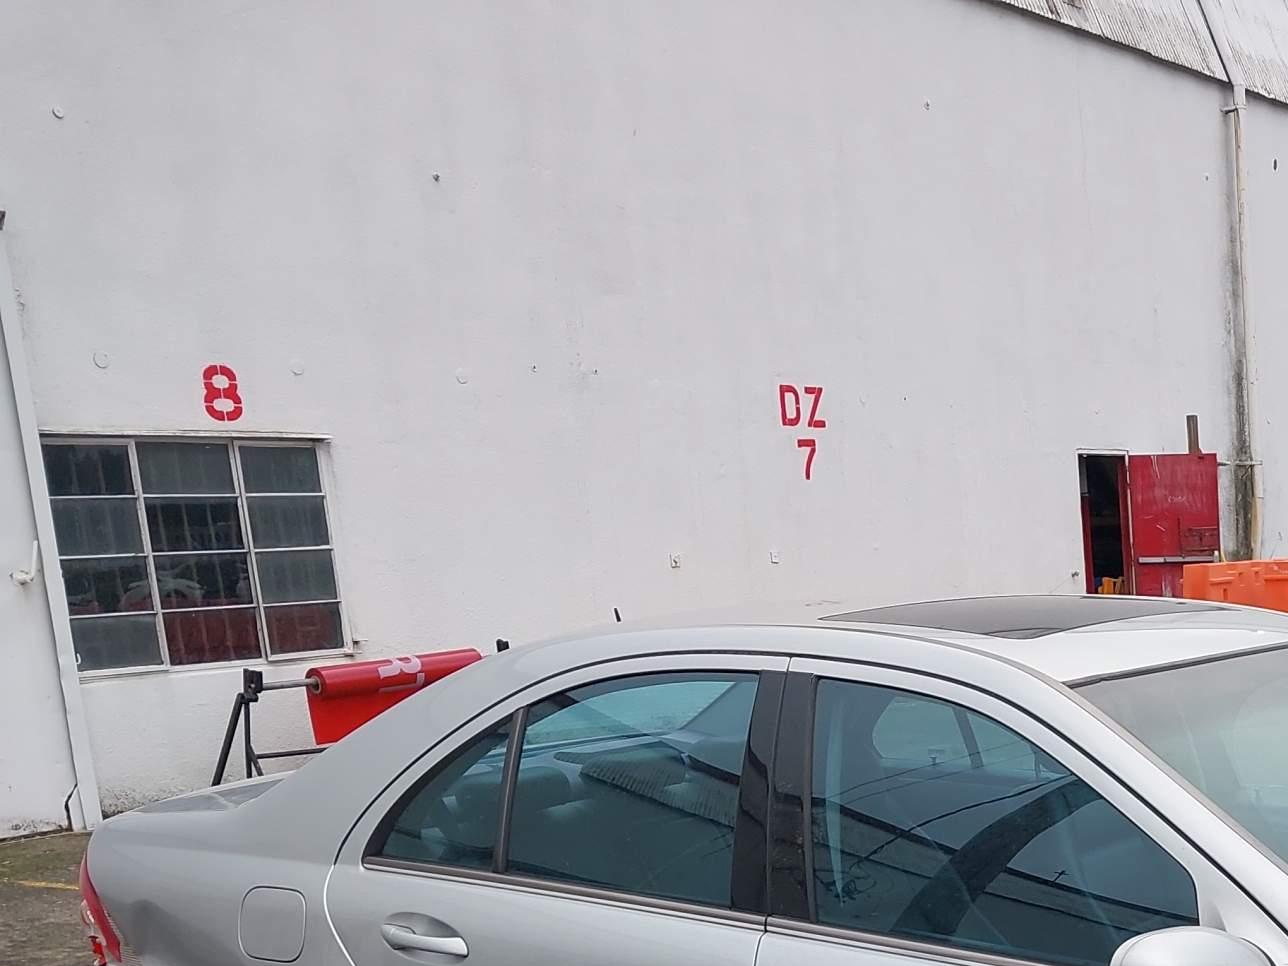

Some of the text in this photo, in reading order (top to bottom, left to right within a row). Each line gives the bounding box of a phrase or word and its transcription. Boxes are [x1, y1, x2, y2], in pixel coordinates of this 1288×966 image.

[202, 364, 244, 423] 8
[779, 384, 827, 428] DZ
[797, 438, 816, 480] 7
